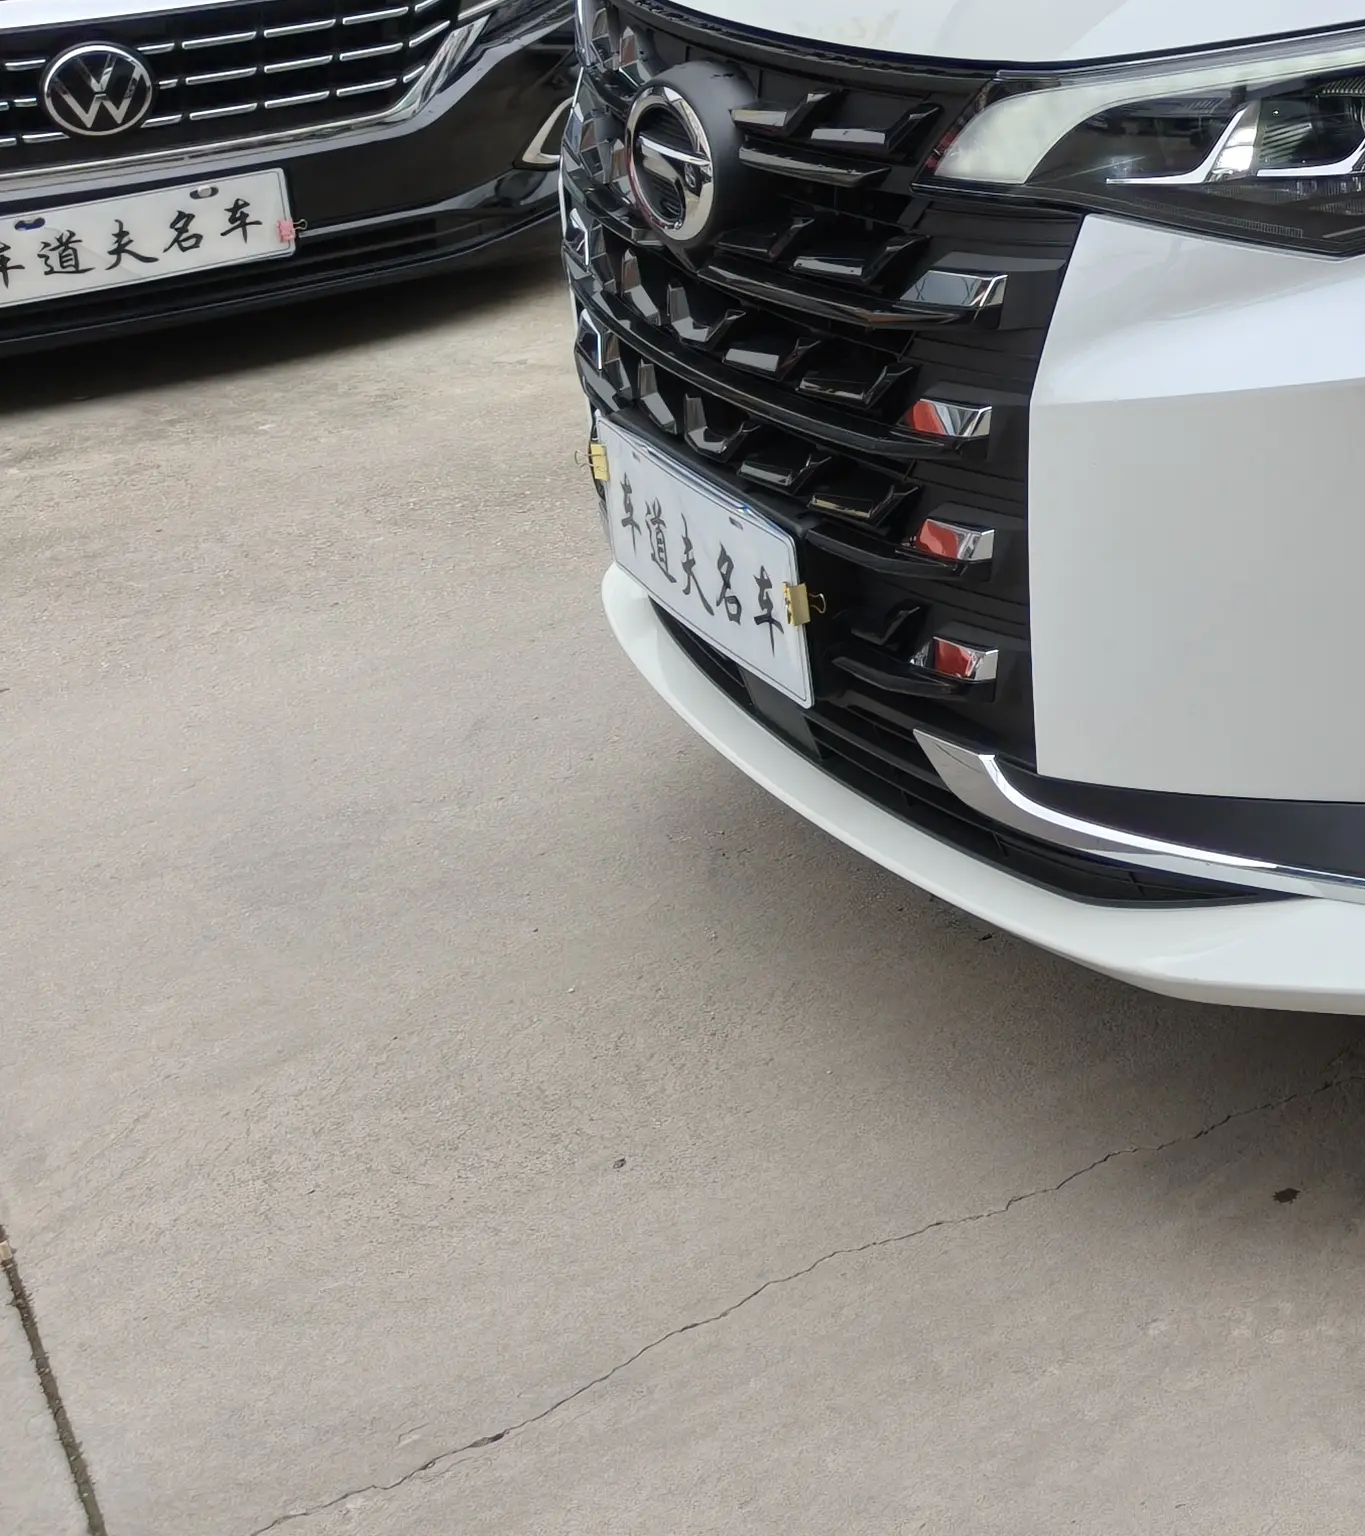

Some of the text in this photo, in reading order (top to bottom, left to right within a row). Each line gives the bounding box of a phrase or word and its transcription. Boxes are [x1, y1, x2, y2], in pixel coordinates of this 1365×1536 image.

[619, 471, 785, 658] 车道夫名车
